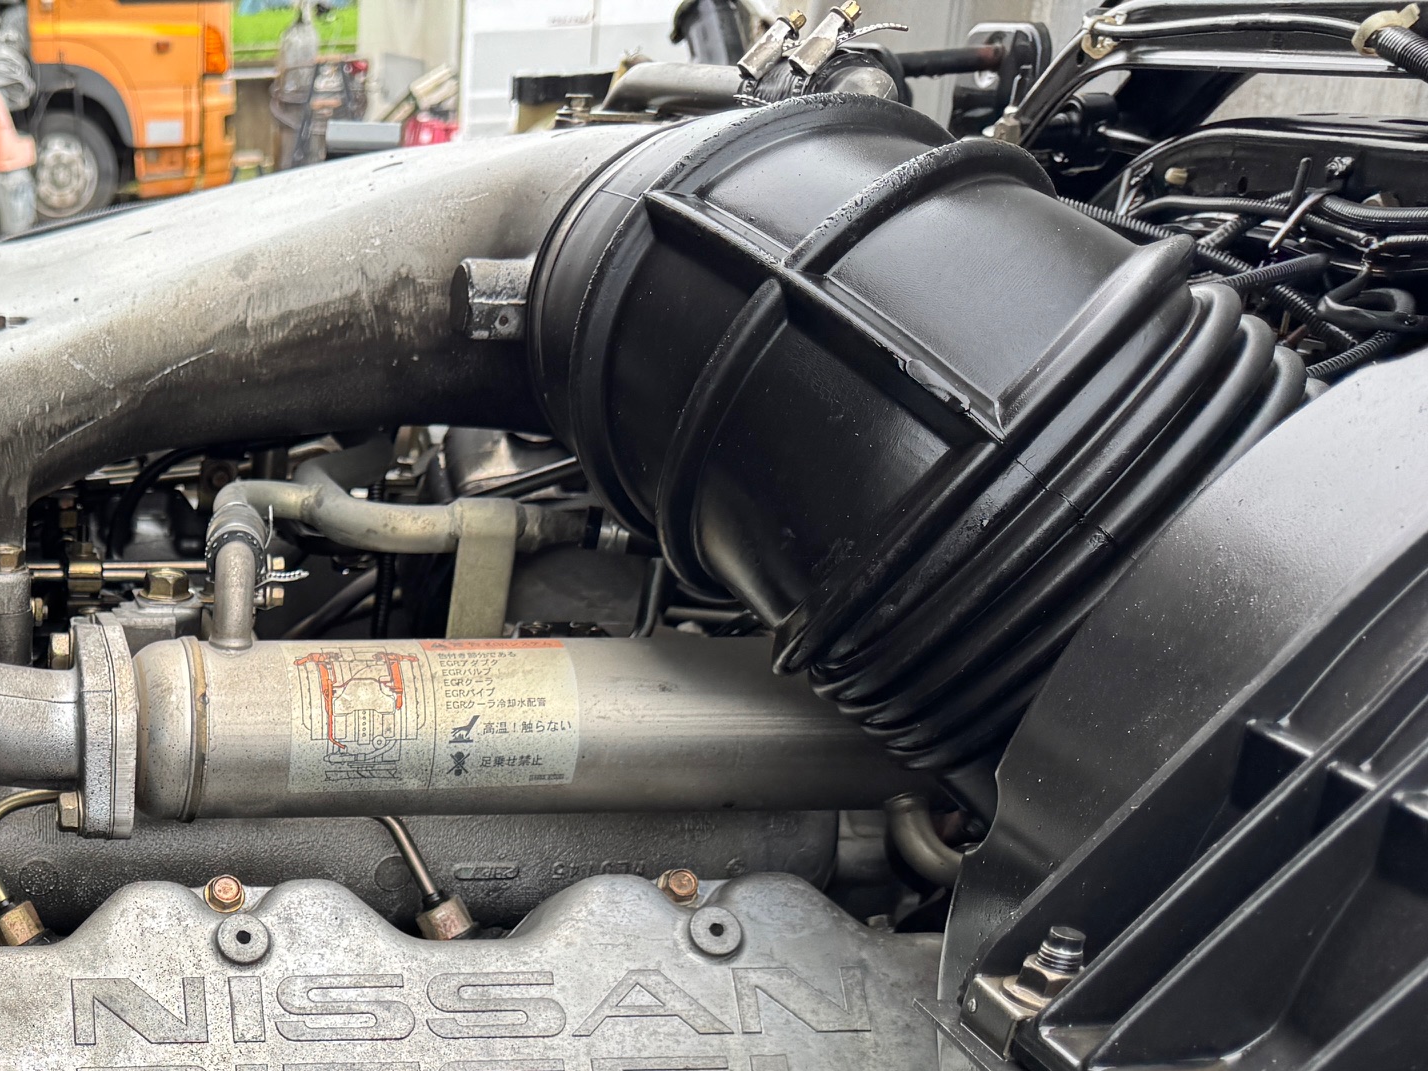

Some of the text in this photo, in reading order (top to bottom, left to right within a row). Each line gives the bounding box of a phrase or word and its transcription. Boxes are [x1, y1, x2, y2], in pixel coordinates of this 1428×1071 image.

[443, 677, 494, 687] EGRクーラ
[480, 754, 544, 768] 足乗せ禁止
[70, 966, 871, 1046] NISSAN
